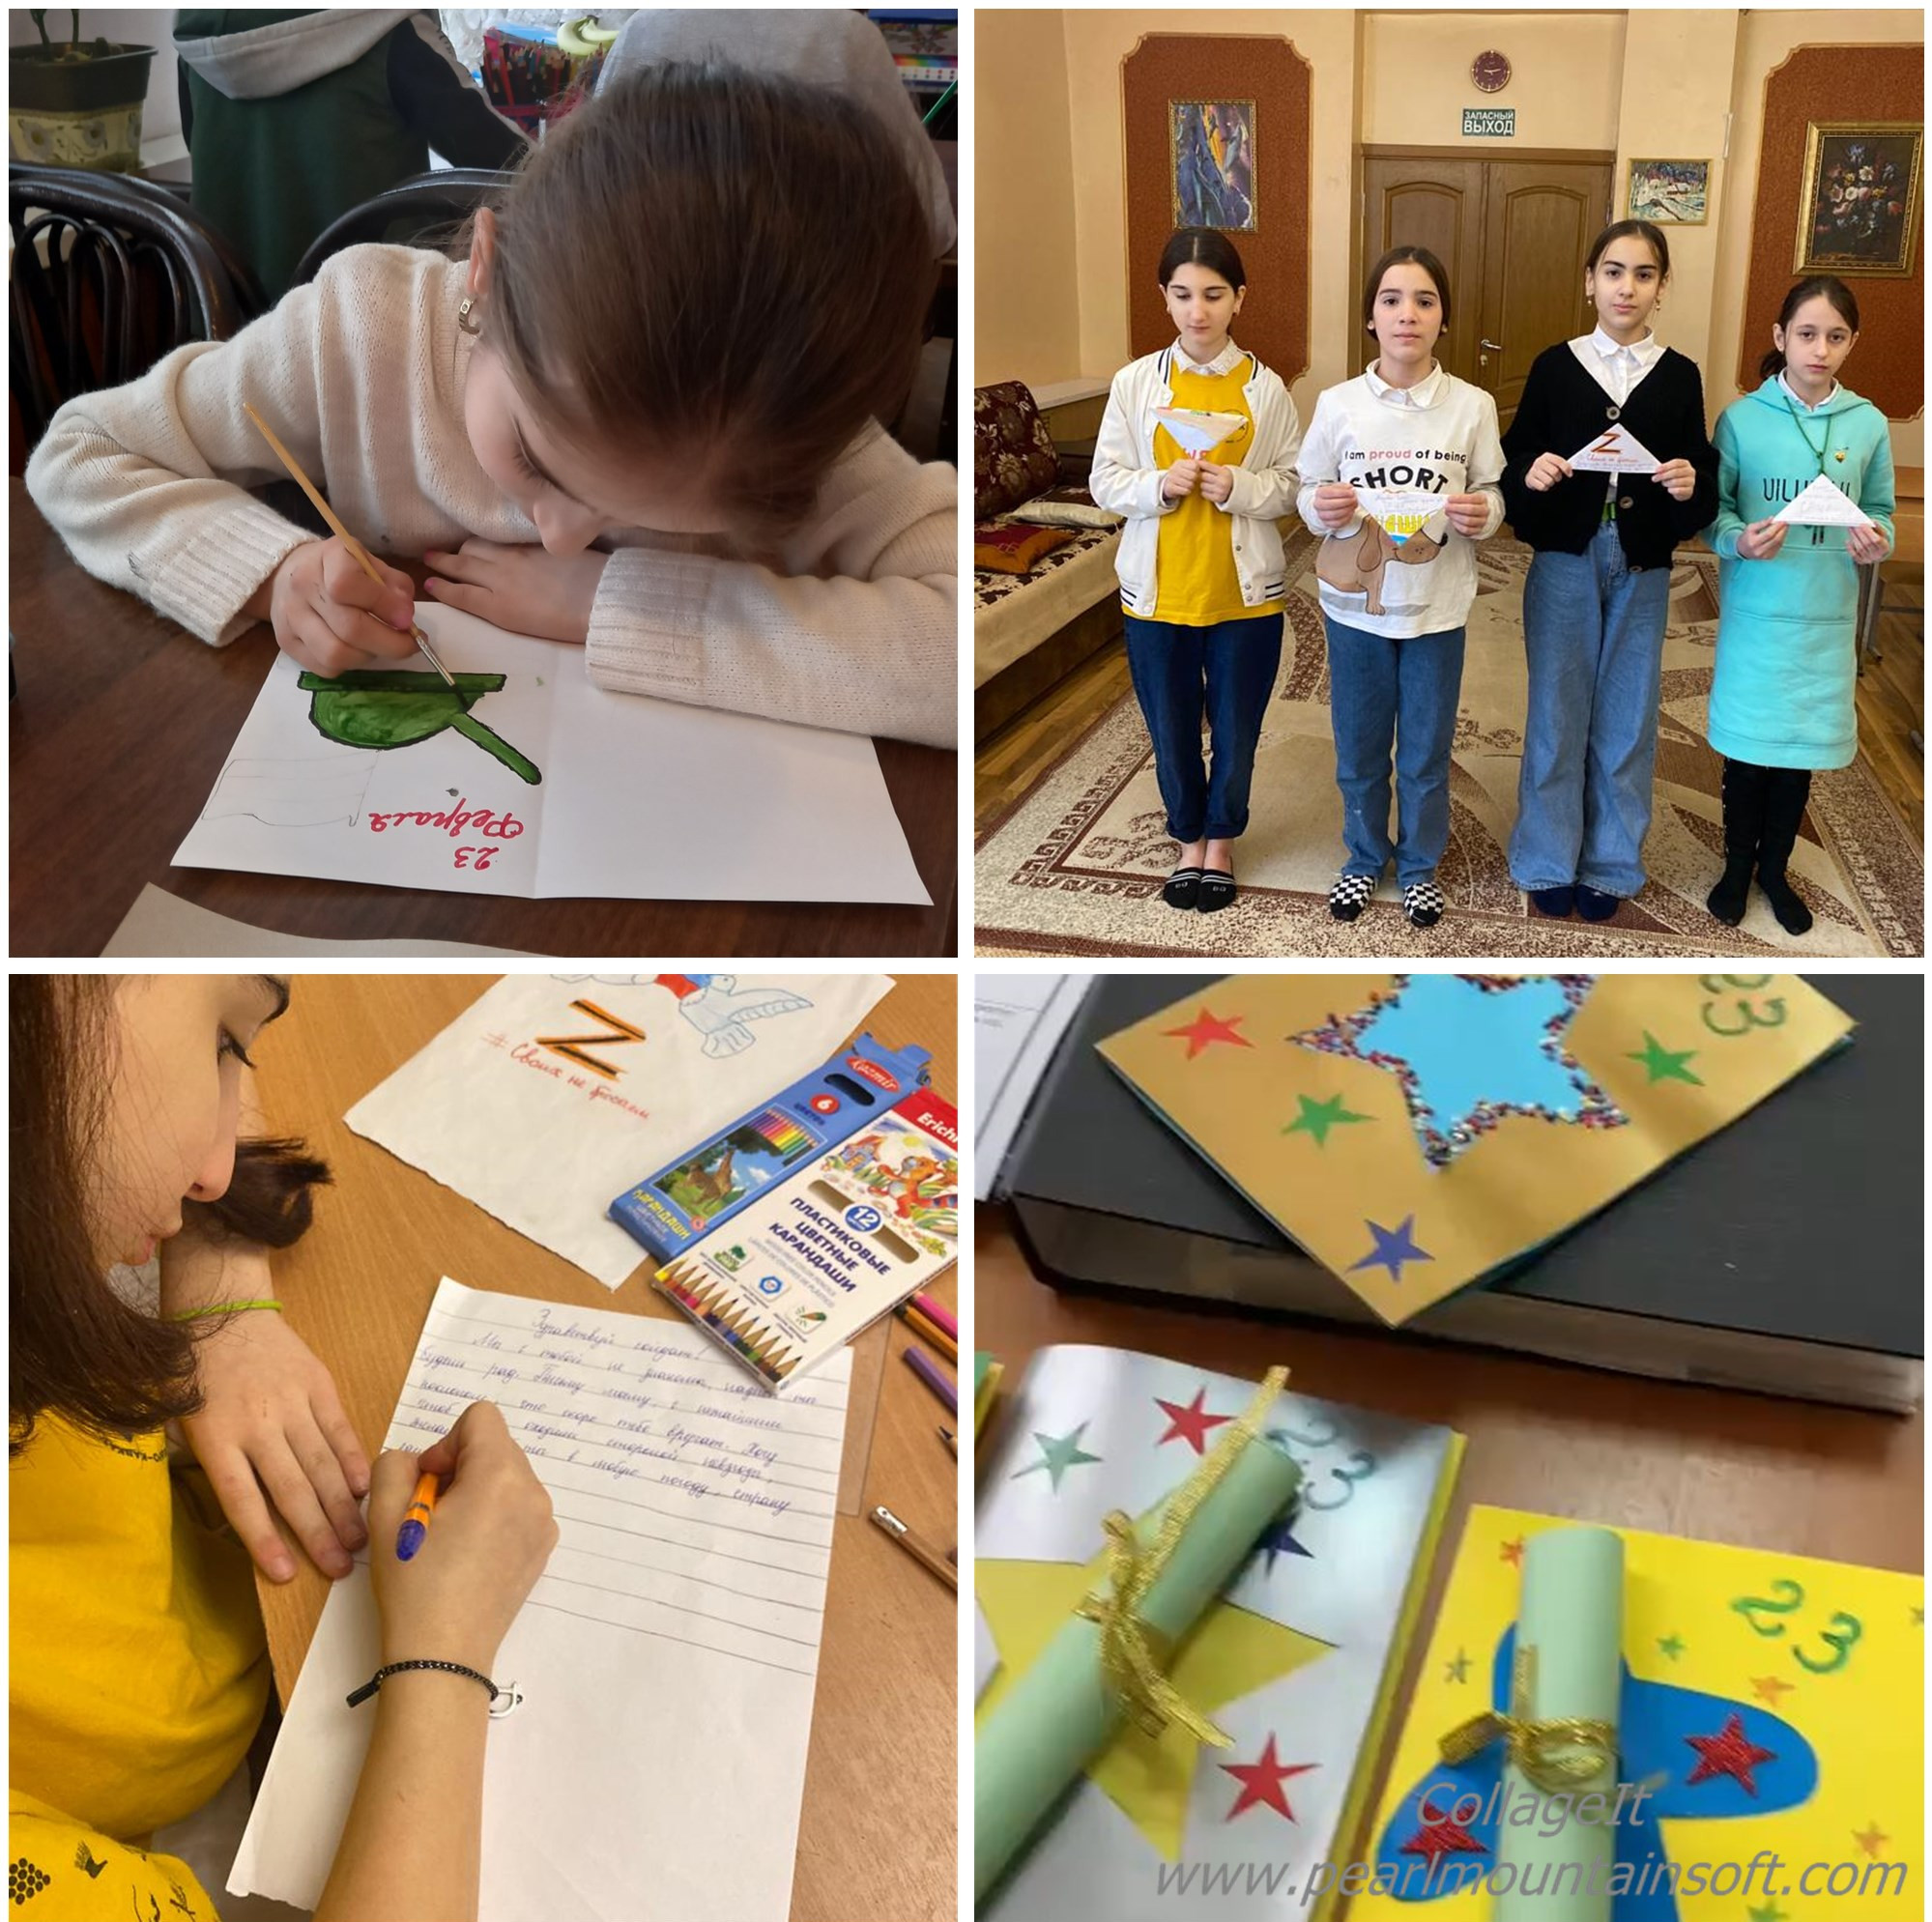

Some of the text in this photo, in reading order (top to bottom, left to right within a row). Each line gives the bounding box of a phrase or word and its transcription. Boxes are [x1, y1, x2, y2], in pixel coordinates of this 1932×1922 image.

[1464, 110, 1514, 120] ЗАПАСНЫЙ
[1464, 120, 1514, 135] ВЫХОД
[1350, 451, 1366, 460] am
[1370, 449, 1412, 461] proud
[1416, 449, 1430, 459] of
[1434, 449, 1467, 464] being
[454, 846, 499, 871] 23
[534, 999, 646, 1082] Z
[817, 1098, 834, 1110] 6
[854, 1207, 879, 1230] 12
[790, 1197, 892, 1277] ПЛАСТИКОВЫЕ
[794, 1221, 860, 1272] ЦВЕТНЫЕ
[768, 1222, 857, 1293] КАРАНДАШИ
[1729, 1578, 1862, 1675] 23
